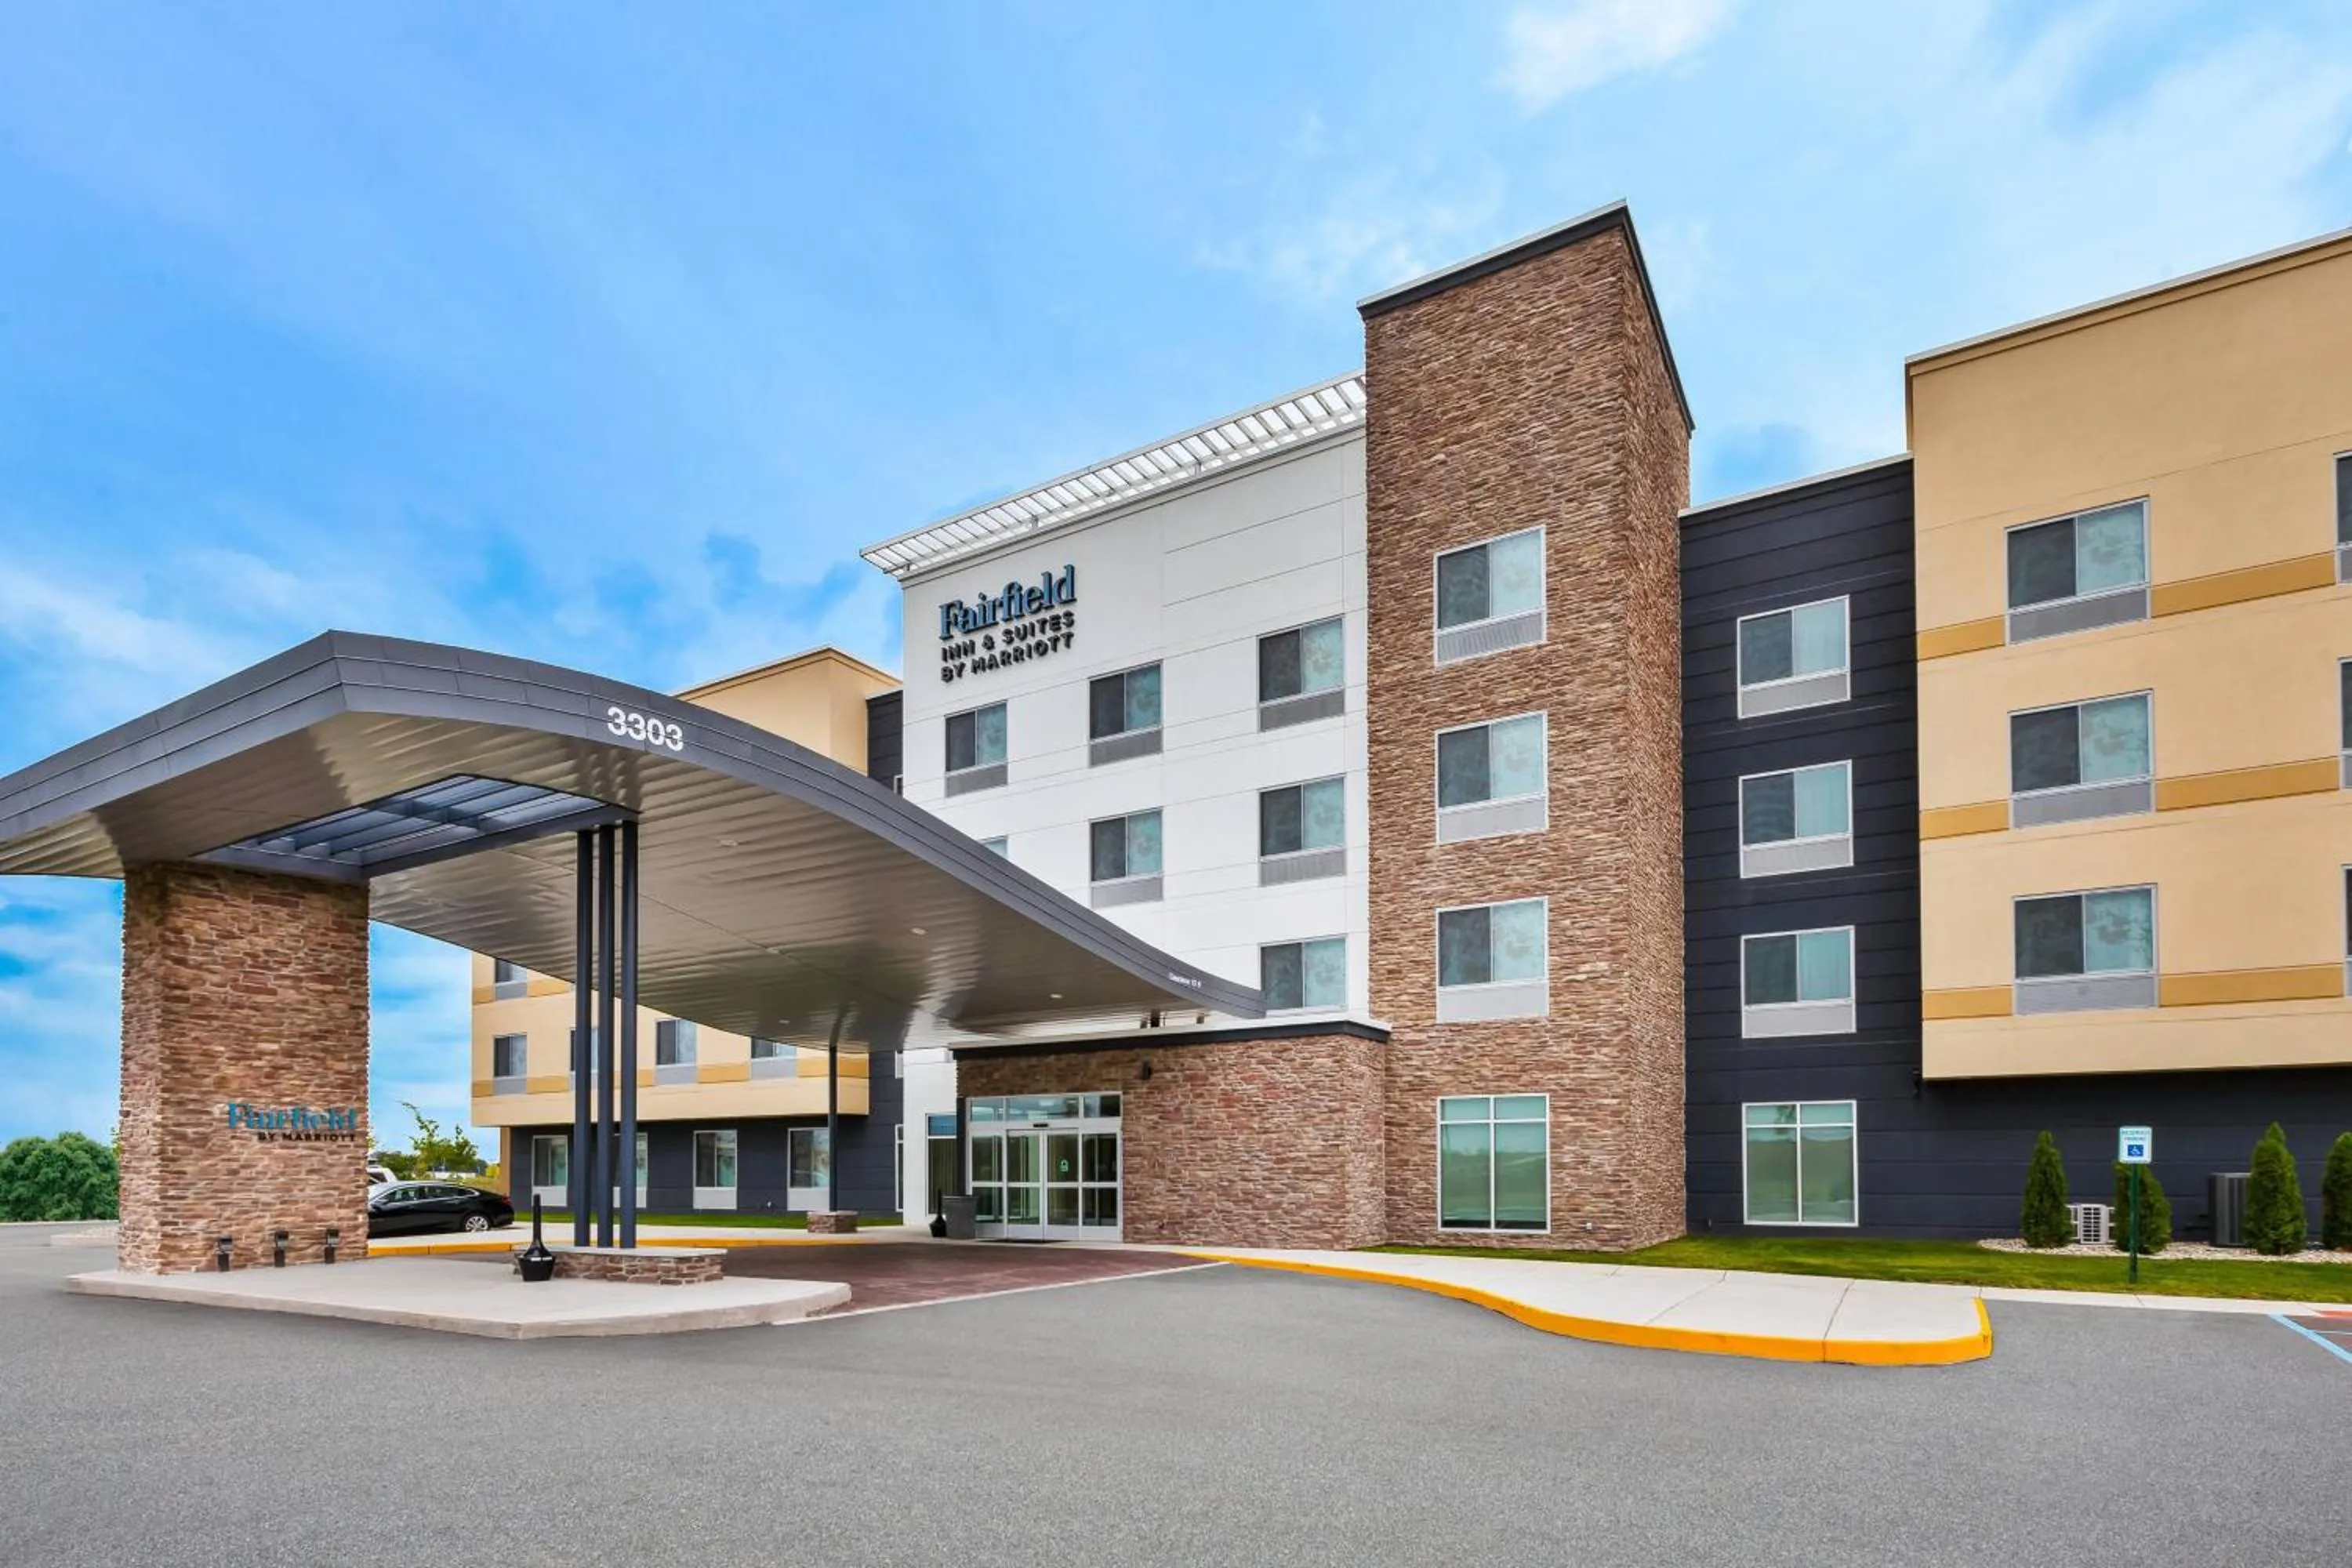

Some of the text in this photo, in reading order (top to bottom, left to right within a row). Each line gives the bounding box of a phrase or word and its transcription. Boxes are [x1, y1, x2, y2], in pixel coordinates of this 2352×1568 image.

[938, 564, 1077, 641] Fairfield
[941, 631, 1075, 683] BY MARRIOTT
[942, 610, 1075, 662] INN & SUITES
[608, 706, 684, 752] 3303
[257, 1131, 356, 1142] BY MARRIOTT
